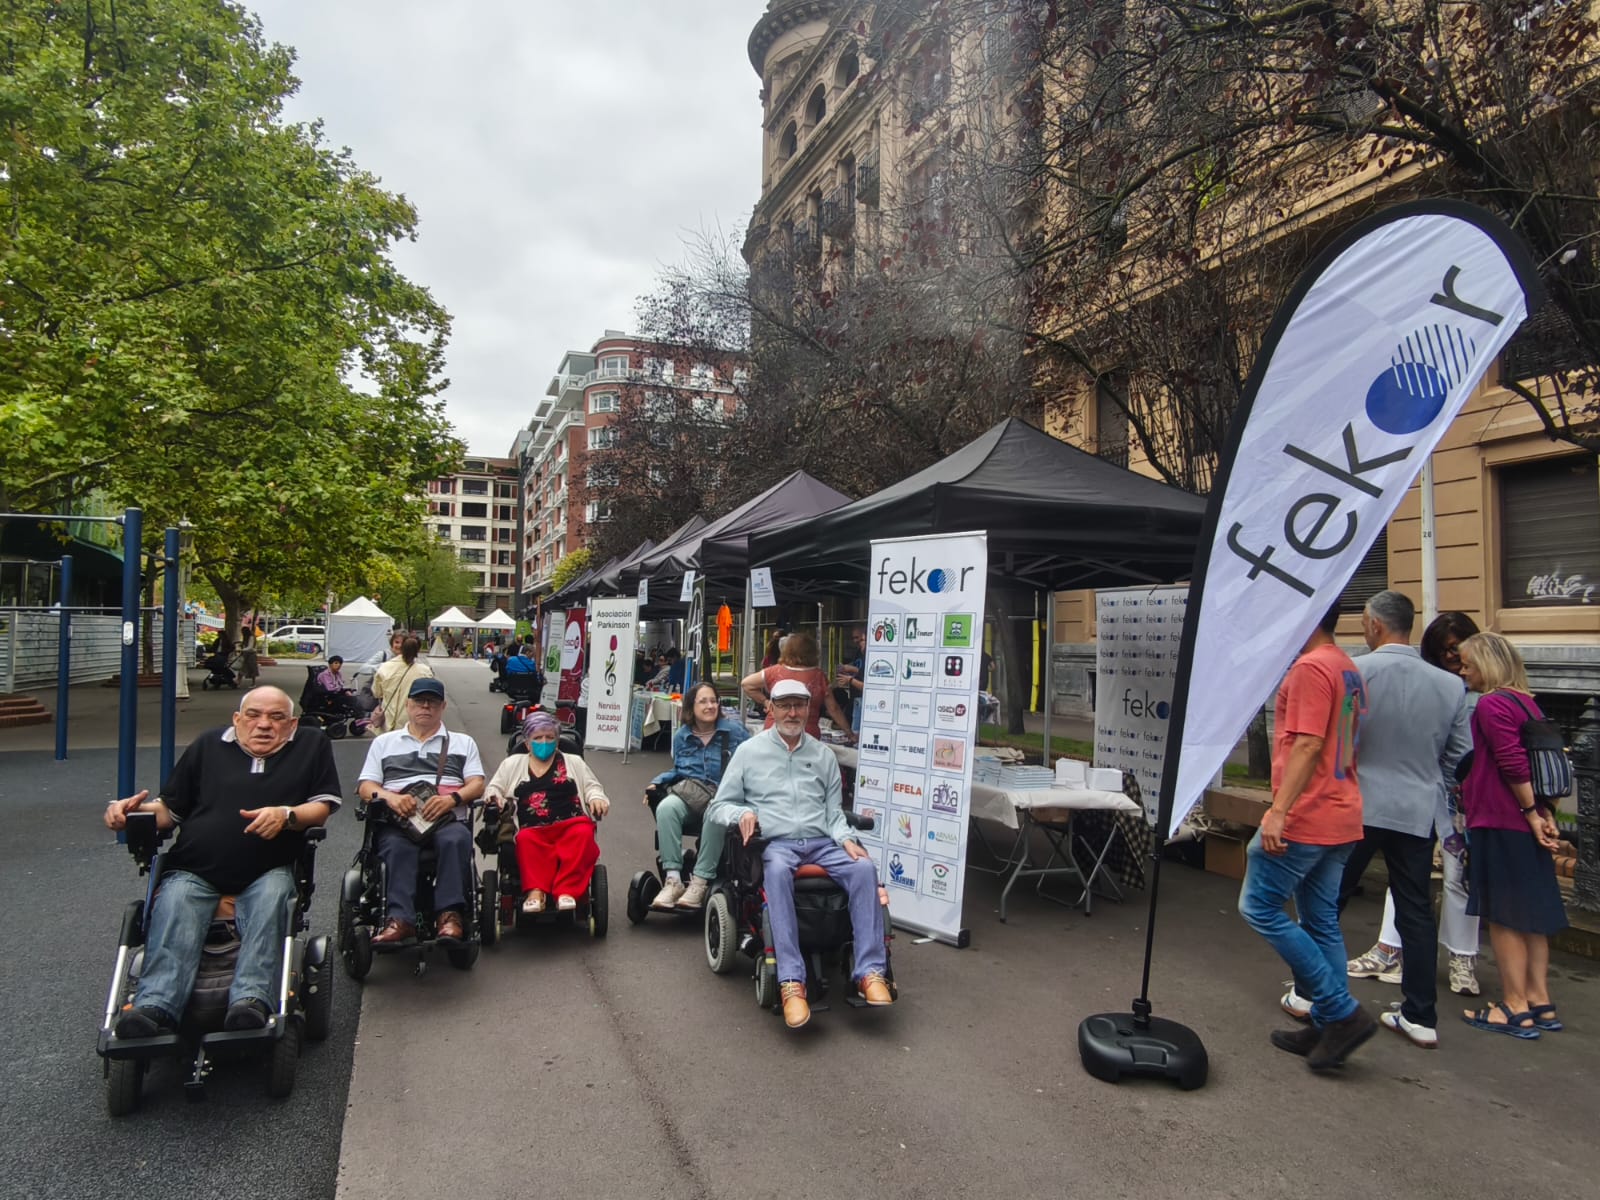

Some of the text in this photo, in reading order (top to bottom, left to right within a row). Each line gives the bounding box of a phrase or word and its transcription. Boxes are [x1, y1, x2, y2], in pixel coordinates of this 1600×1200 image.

[878, 556, 974, 594] fekor
[597, 621, 630, 629] Parkinson
[1122, 688, 1170, 720] feko
[894, 783, 922, 796] EFELA
